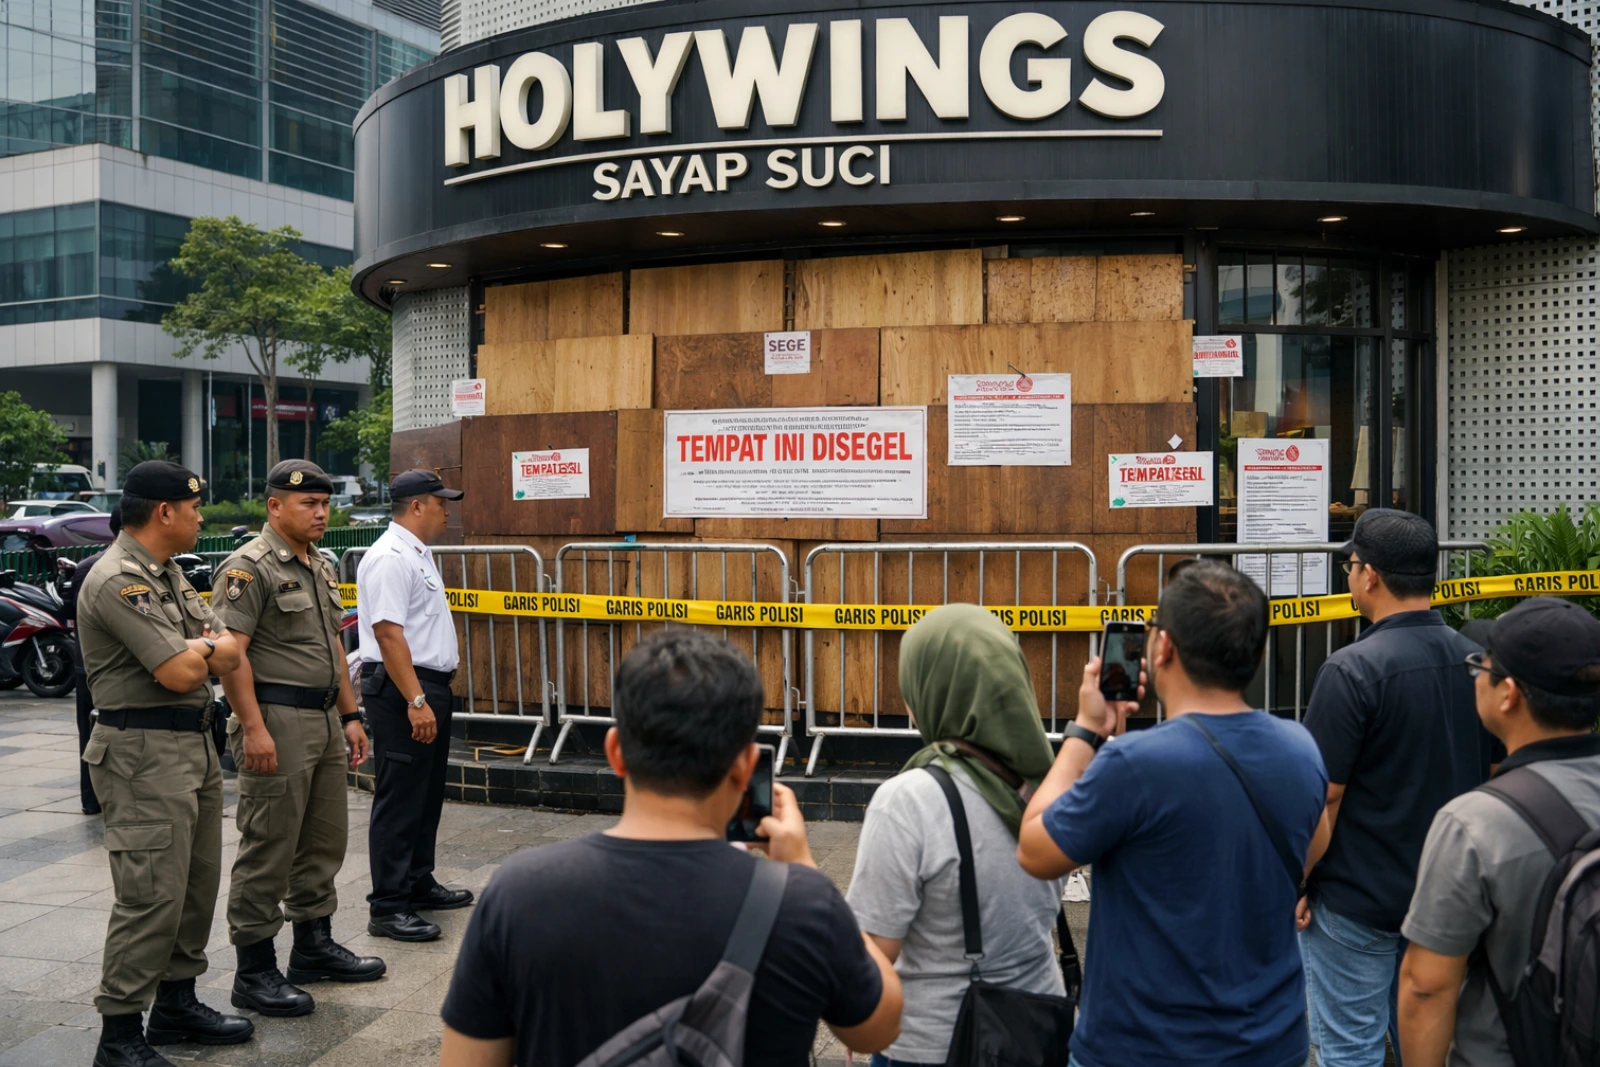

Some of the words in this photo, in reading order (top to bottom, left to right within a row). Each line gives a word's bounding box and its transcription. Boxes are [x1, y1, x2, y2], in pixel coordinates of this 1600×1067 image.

[444, 10, 1166, 167] HOLYWINGS
[592, 151, 749, 201] SAYAP
[766, 145, 891, 190] SUCI
[768, 338, 806, 352] SEGE
[677, 434, 767, 462] TEMPAT
[774, 433, 804, 461] INI
[812, 432, 912, 460] DISEGEL
[1432, 581, 1481, 600] POLISI
[1514, 576, 1562, 592] GARIS
[503, 595, 538, 611] GARIS
[542, 598, 580, 613] POLISI
[606, 600, 642, 616] GARIS
[647, 601, 688, 618] POLISI
[1272, 600, 1320, 620] POLISI
[716, 604, 755, 621] GARIS
[760, 606, 803, 623] POLISI
[834, 608, 876, 625] GARIS
[1019, 609, 1067, 627] POLISI
